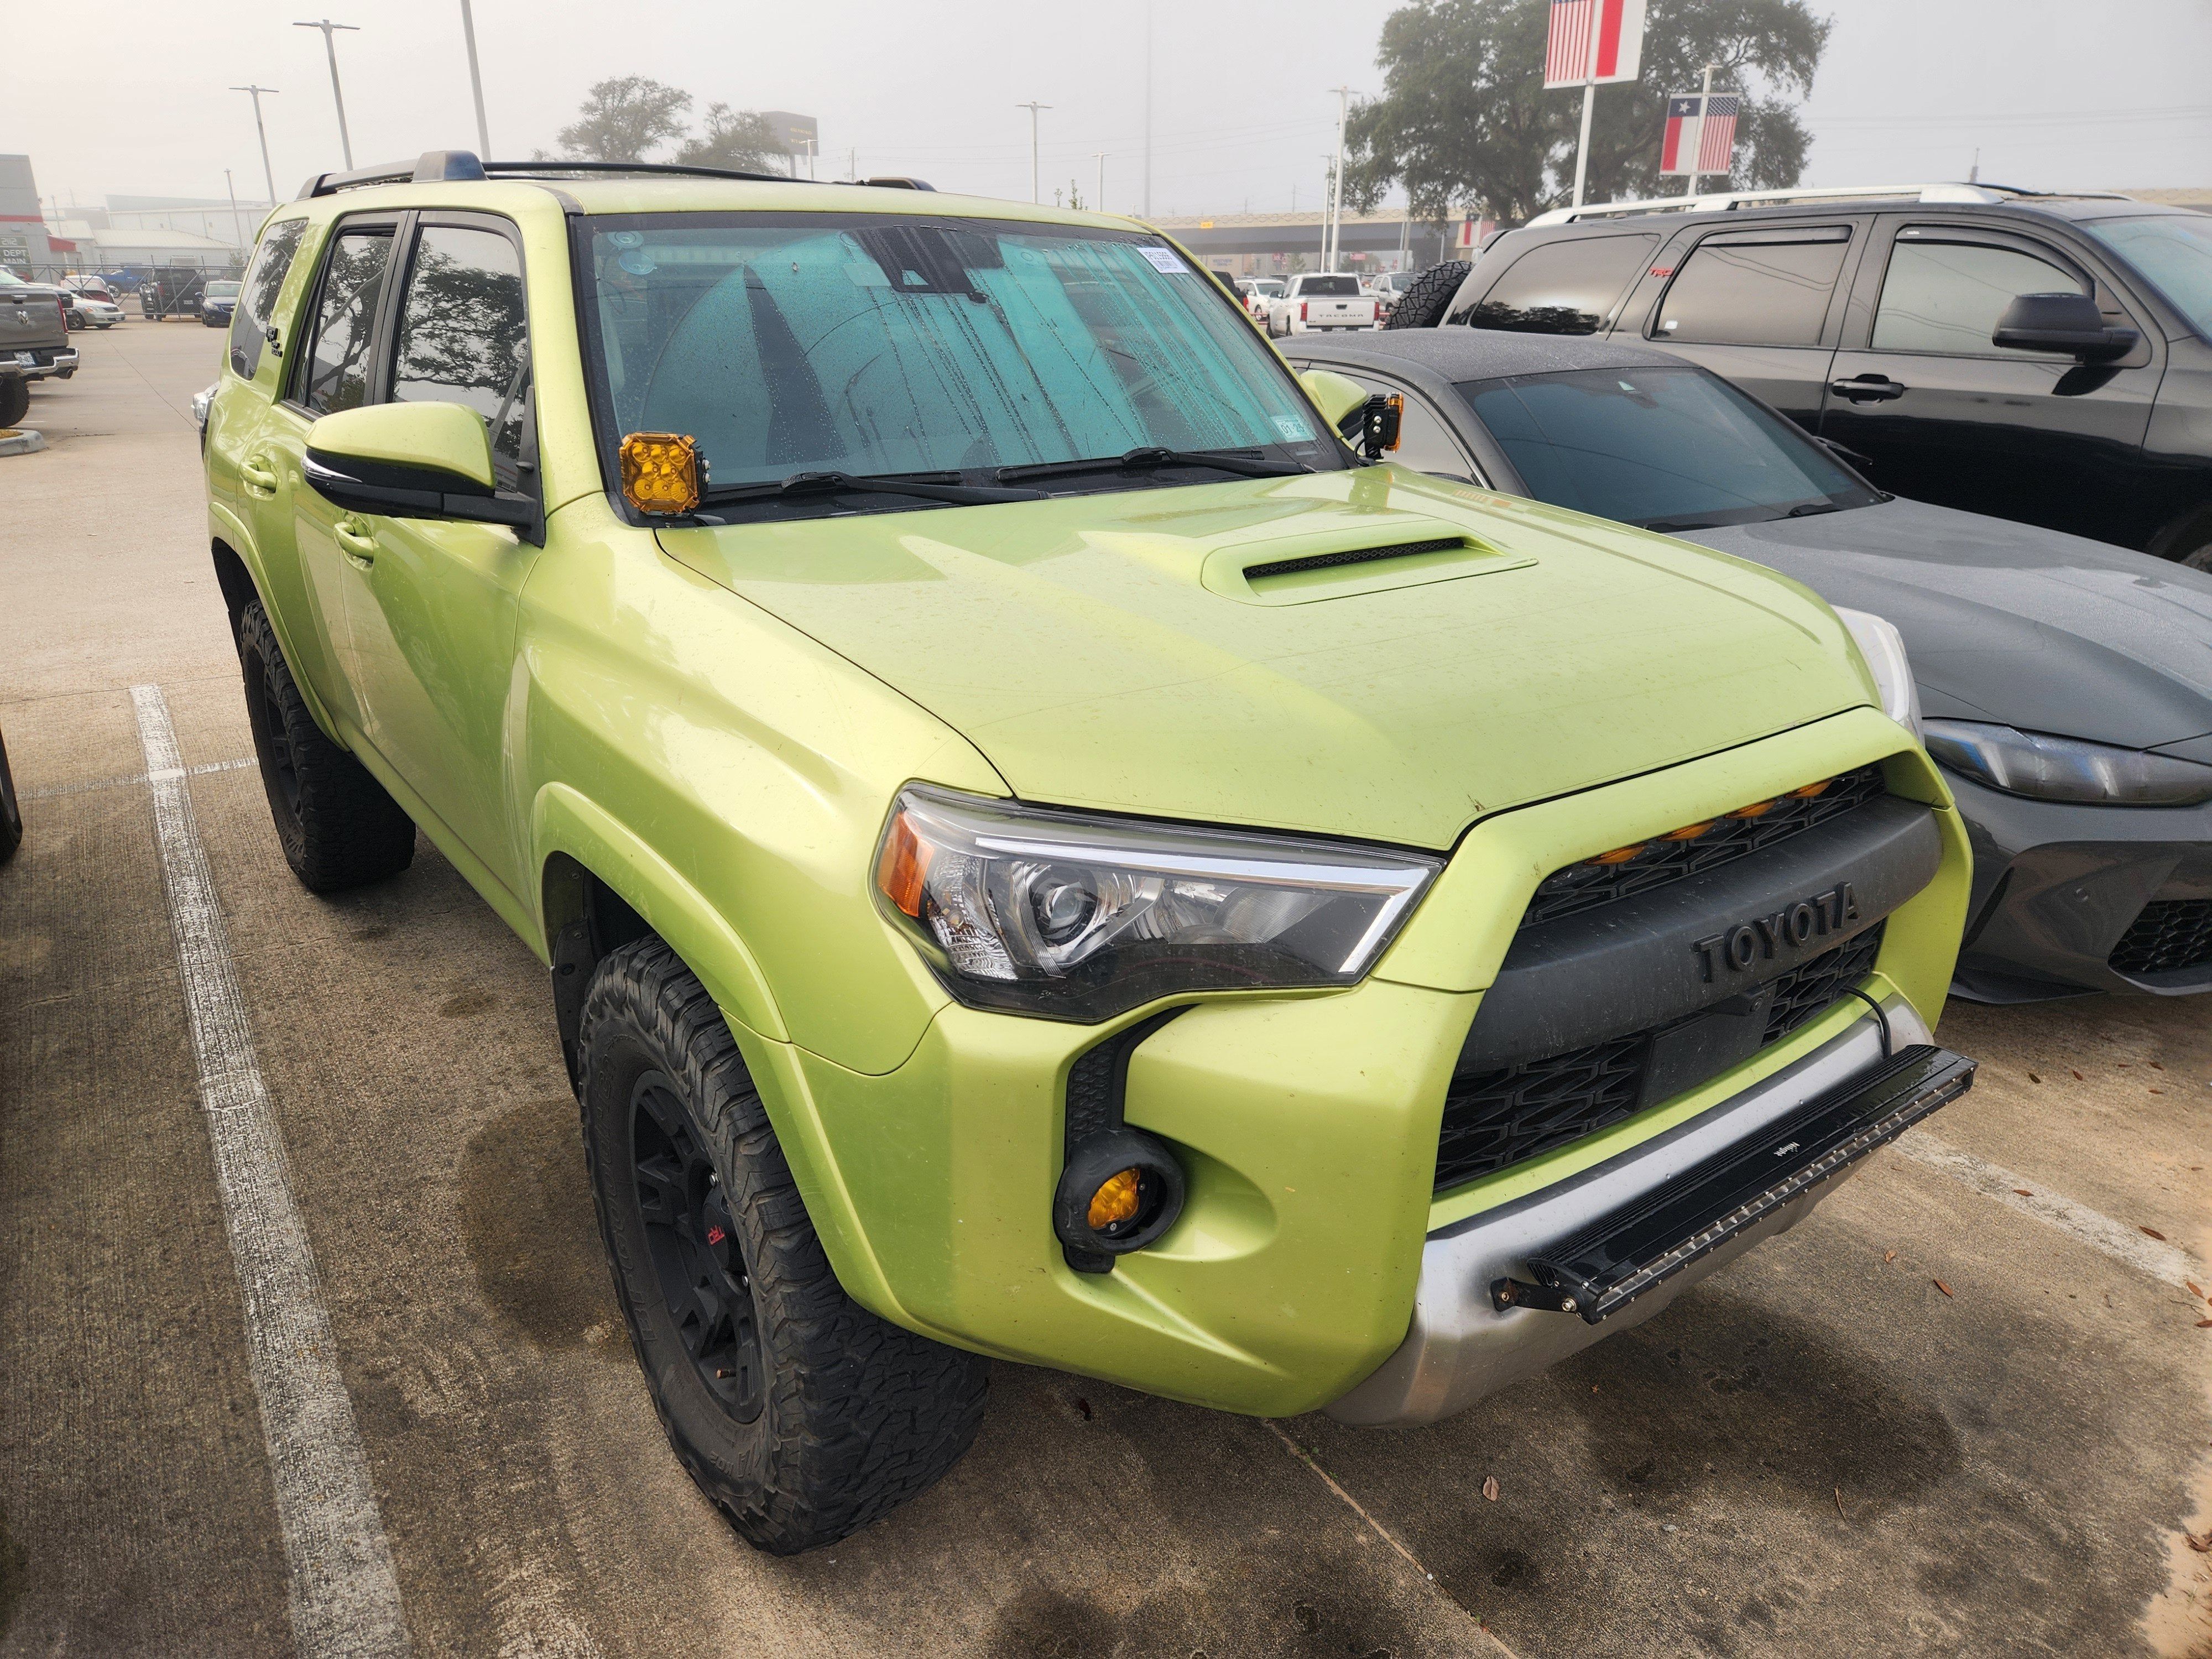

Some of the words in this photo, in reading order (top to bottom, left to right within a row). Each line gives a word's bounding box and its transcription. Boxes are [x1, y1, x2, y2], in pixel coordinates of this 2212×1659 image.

[1693, 881, 1859, 983] TOYOTA
[1773, 1141, 1801, 1157] Nilight
[708, 1224, 724, 1245] TRD
